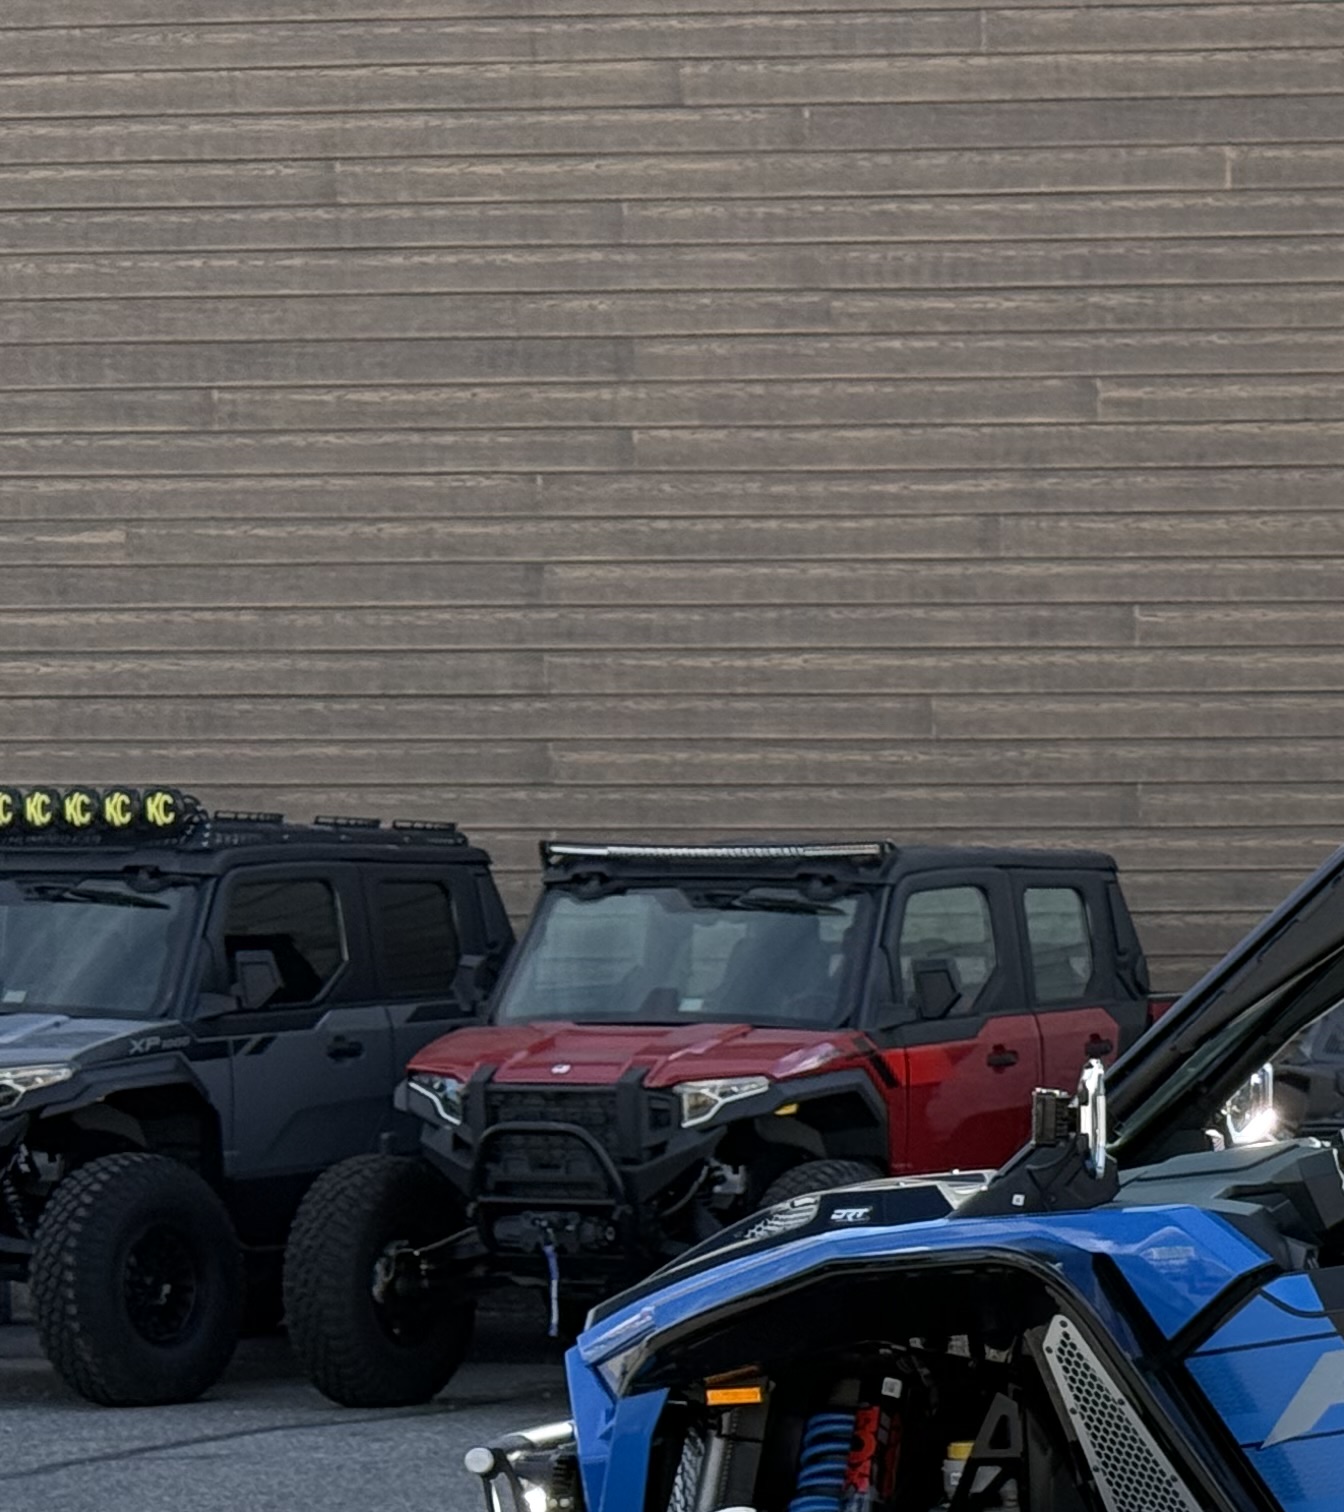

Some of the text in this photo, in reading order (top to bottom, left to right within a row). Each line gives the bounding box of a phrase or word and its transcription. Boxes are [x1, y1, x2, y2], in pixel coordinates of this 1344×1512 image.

[26, 792, 51, 826] KC
[65, 792, 91, 826] KC
[106, 792, 132, 826] KC
[148, 792, 175, 826] KC
[129, 1036, 160, 1055] XP
